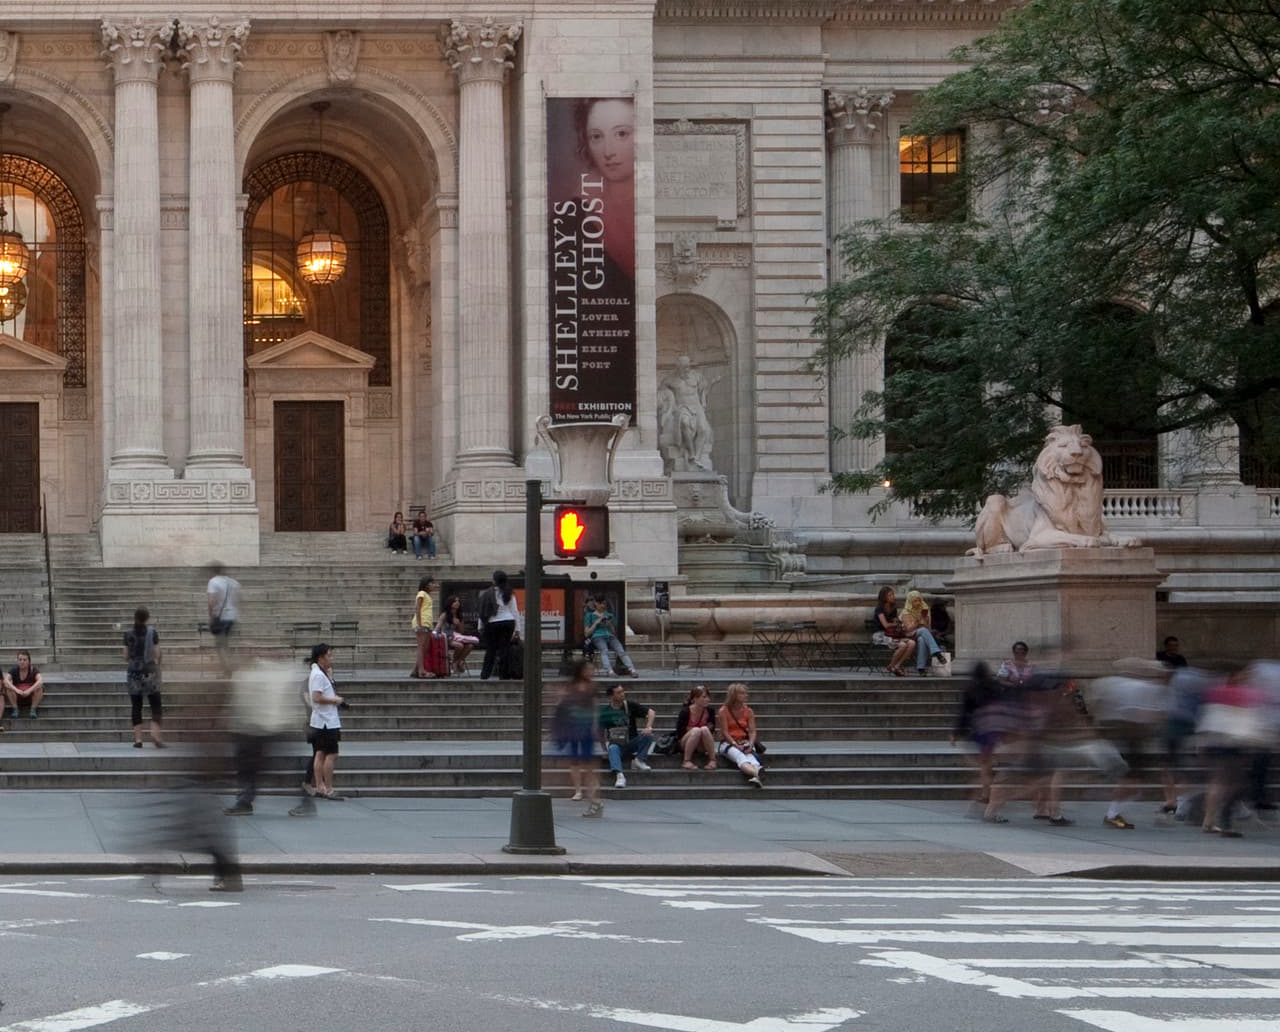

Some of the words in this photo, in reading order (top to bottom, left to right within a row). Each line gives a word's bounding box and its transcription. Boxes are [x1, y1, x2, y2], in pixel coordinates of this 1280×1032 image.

[580, 172, 606, 291] GHOST
[554, 199, 580, 392] SHELLEY'S
[580, 297, 631, 306] RADICAL
[581, 313, 619, 322] LOVER
[581, 329, 631, 338] ATHEIST
[581, 345, 618, 354] EXILE
[581, 361, 611, 370] POET
[578, 402, 632, 411] EXHIBITION
[540, 609, 561, 617] ourt
